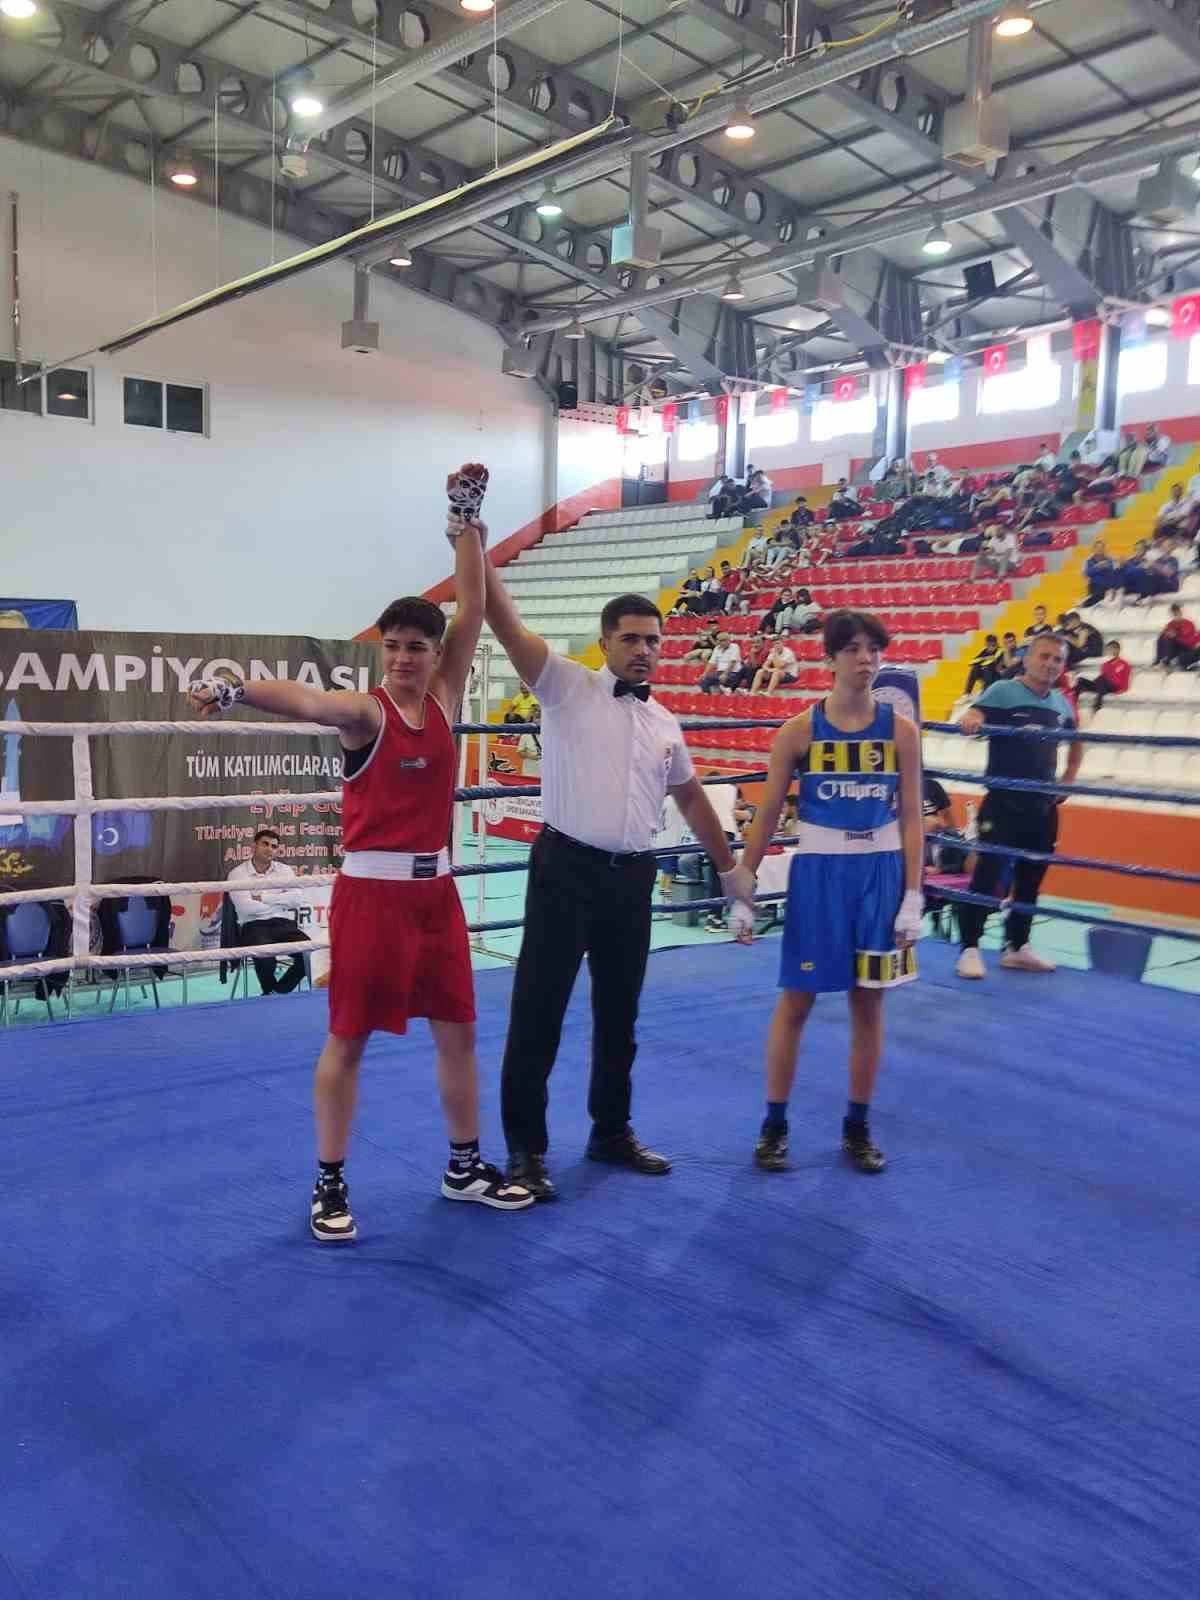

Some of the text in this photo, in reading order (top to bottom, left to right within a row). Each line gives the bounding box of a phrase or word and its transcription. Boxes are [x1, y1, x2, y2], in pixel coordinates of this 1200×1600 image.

[0, 645, 369, 694] AMPİYONASI
[187, 750, 220, 777] TÜM
[224, 754, 330, 777] KATILIMCILARA
